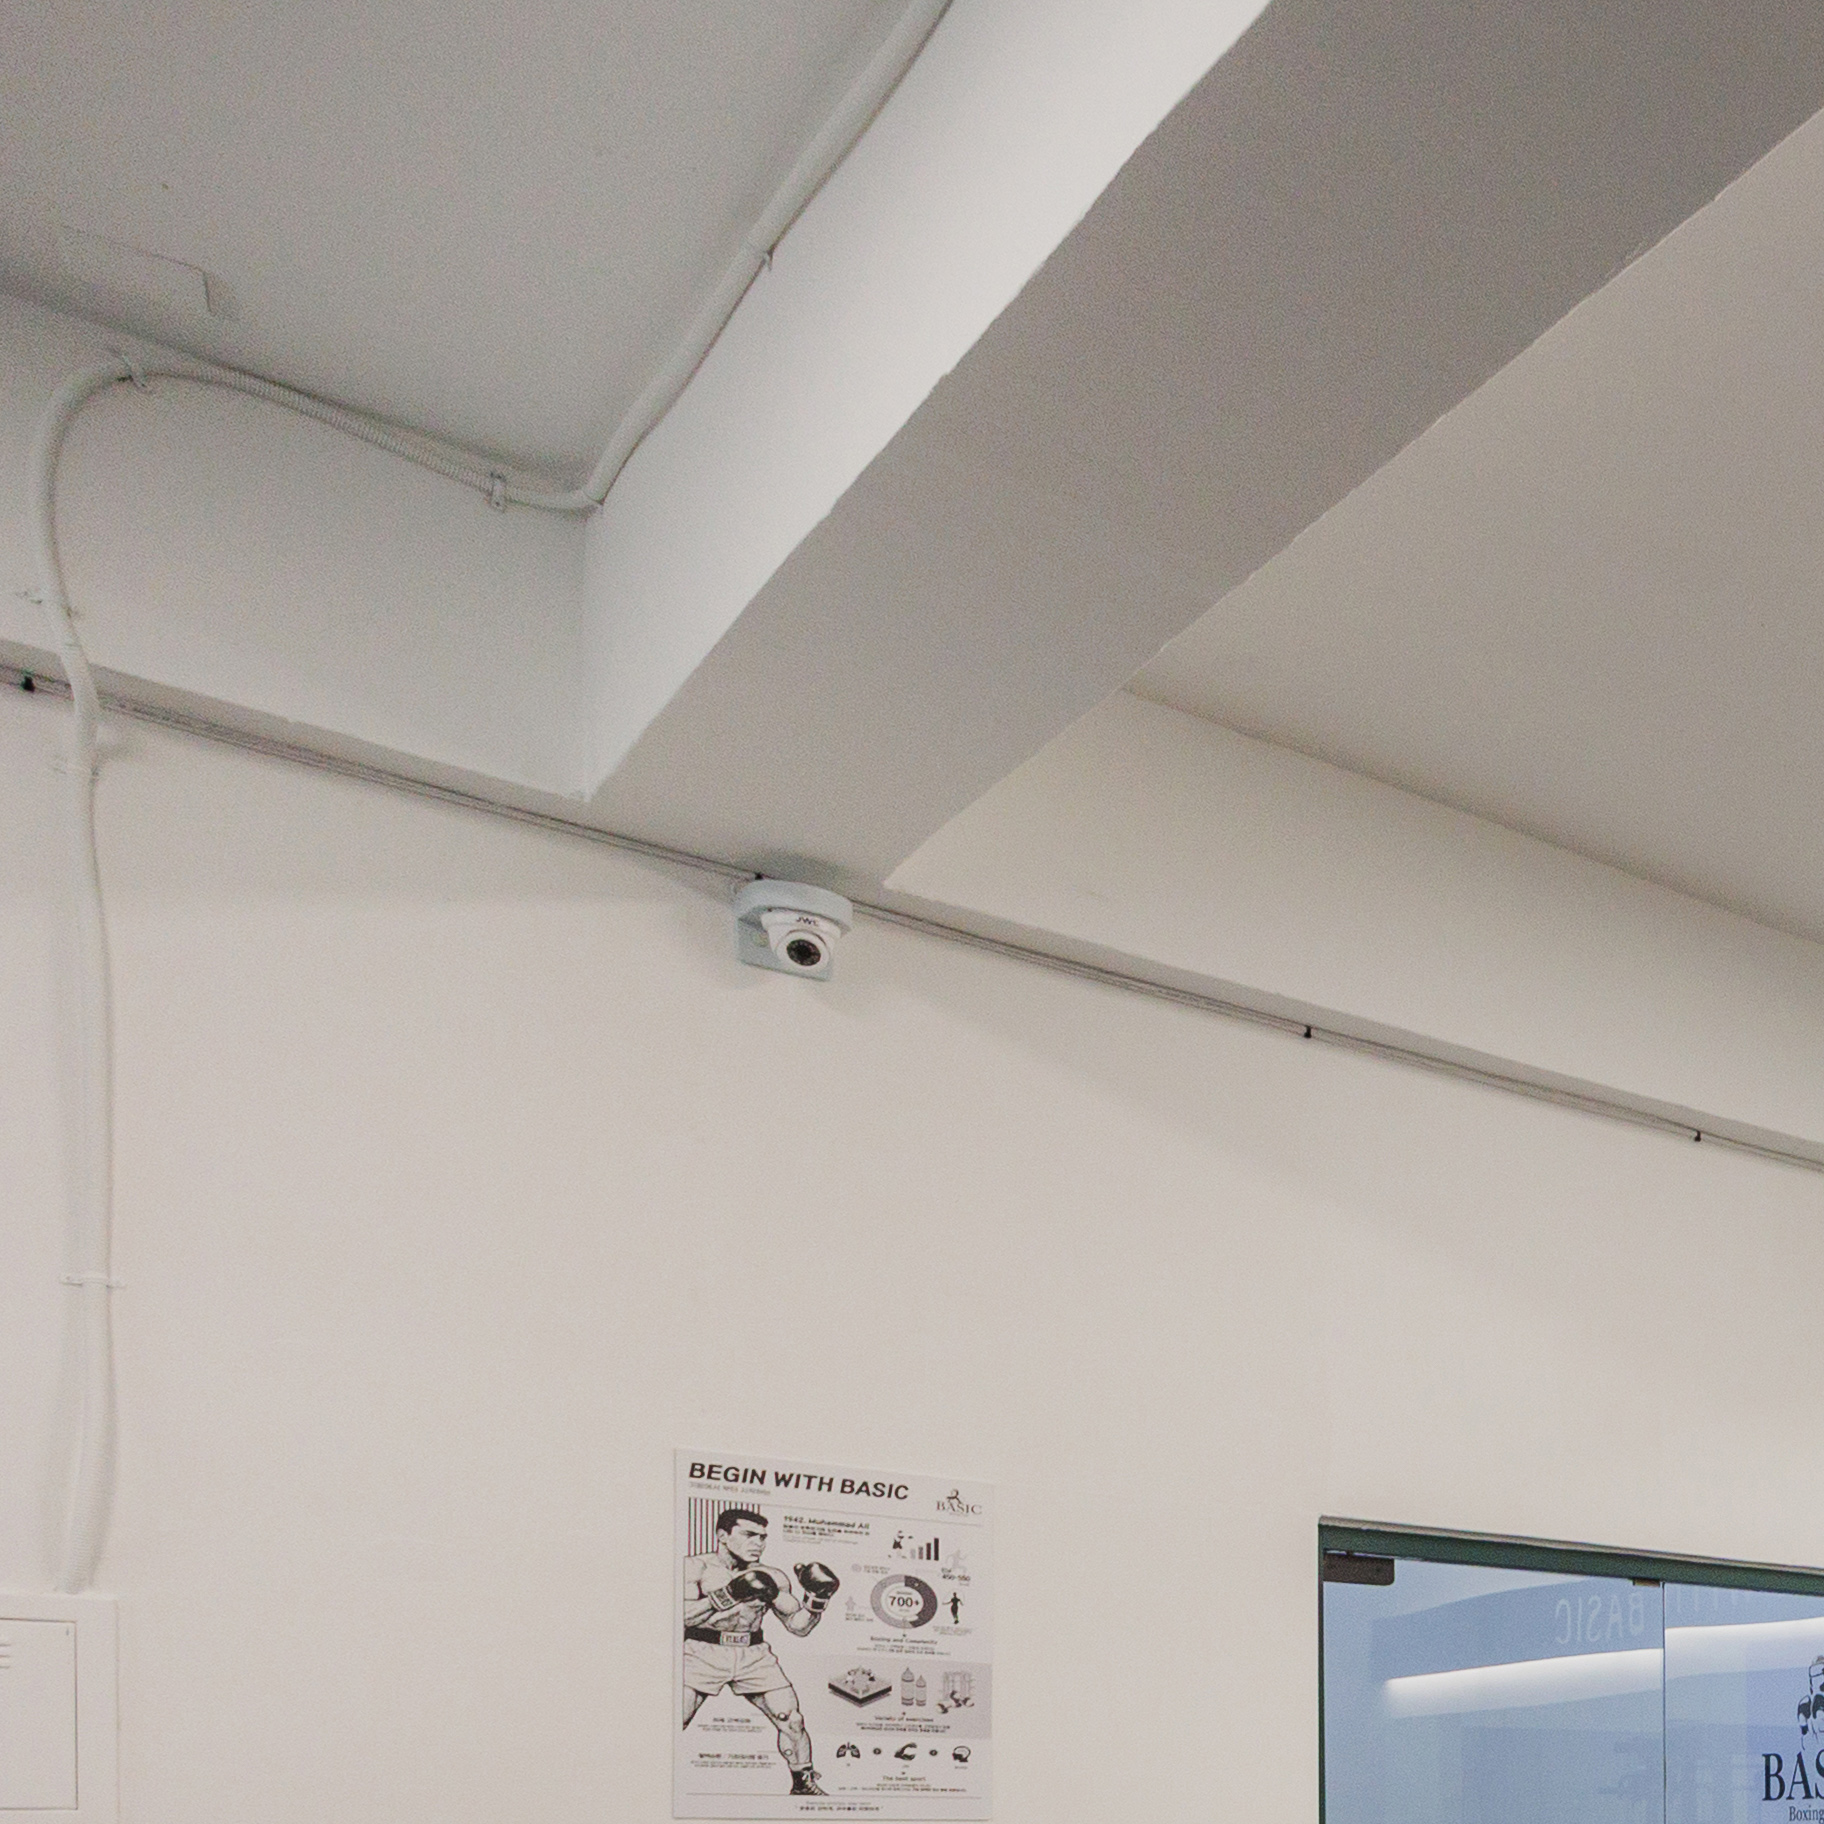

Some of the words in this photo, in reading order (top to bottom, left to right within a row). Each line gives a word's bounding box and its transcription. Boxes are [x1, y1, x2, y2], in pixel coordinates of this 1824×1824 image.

[688, 1462, 767, 1486] BEGIN
[774, 1471, 834, 1493] WITH
[839, 1478, 910, 1500] BASIC
[935, 1500, 983, 1516] BASIC
[888, 1595, 920, 1609] 700+
[1789, 1804, 1824, 1824] Boxing
